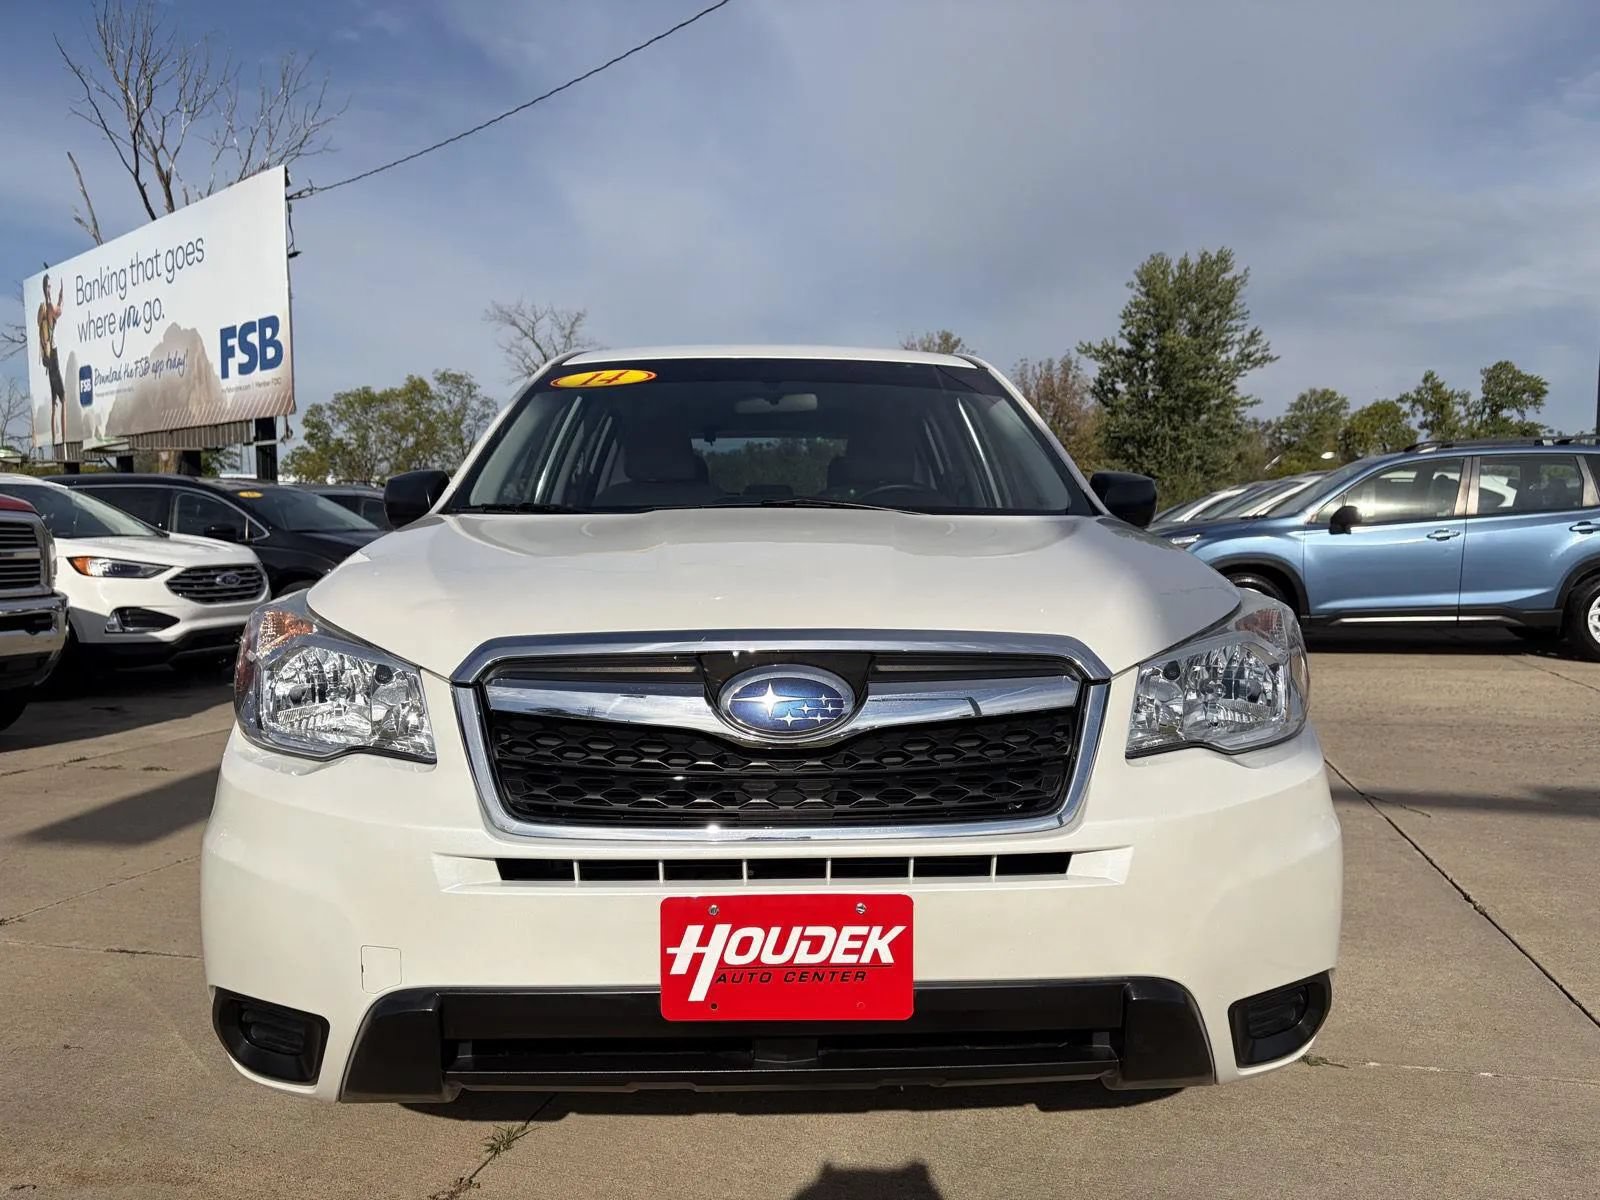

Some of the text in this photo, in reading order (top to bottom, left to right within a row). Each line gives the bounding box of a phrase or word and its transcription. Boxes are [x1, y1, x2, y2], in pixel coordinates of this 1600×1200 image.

[76, 237, 204, 306] Banking that goes
[77, 298, 165, 358] where you go.
[220, 315, 284, 379] FSB
[80, 379, 92, 393] FSB
[94, 348, 189, 387] Download the FSB app today!
[578, 370, 629, 386] 14
[666, 924, 907, 1002] HOUDEK
[715, 971, 867, 984] AUTO CENTER
